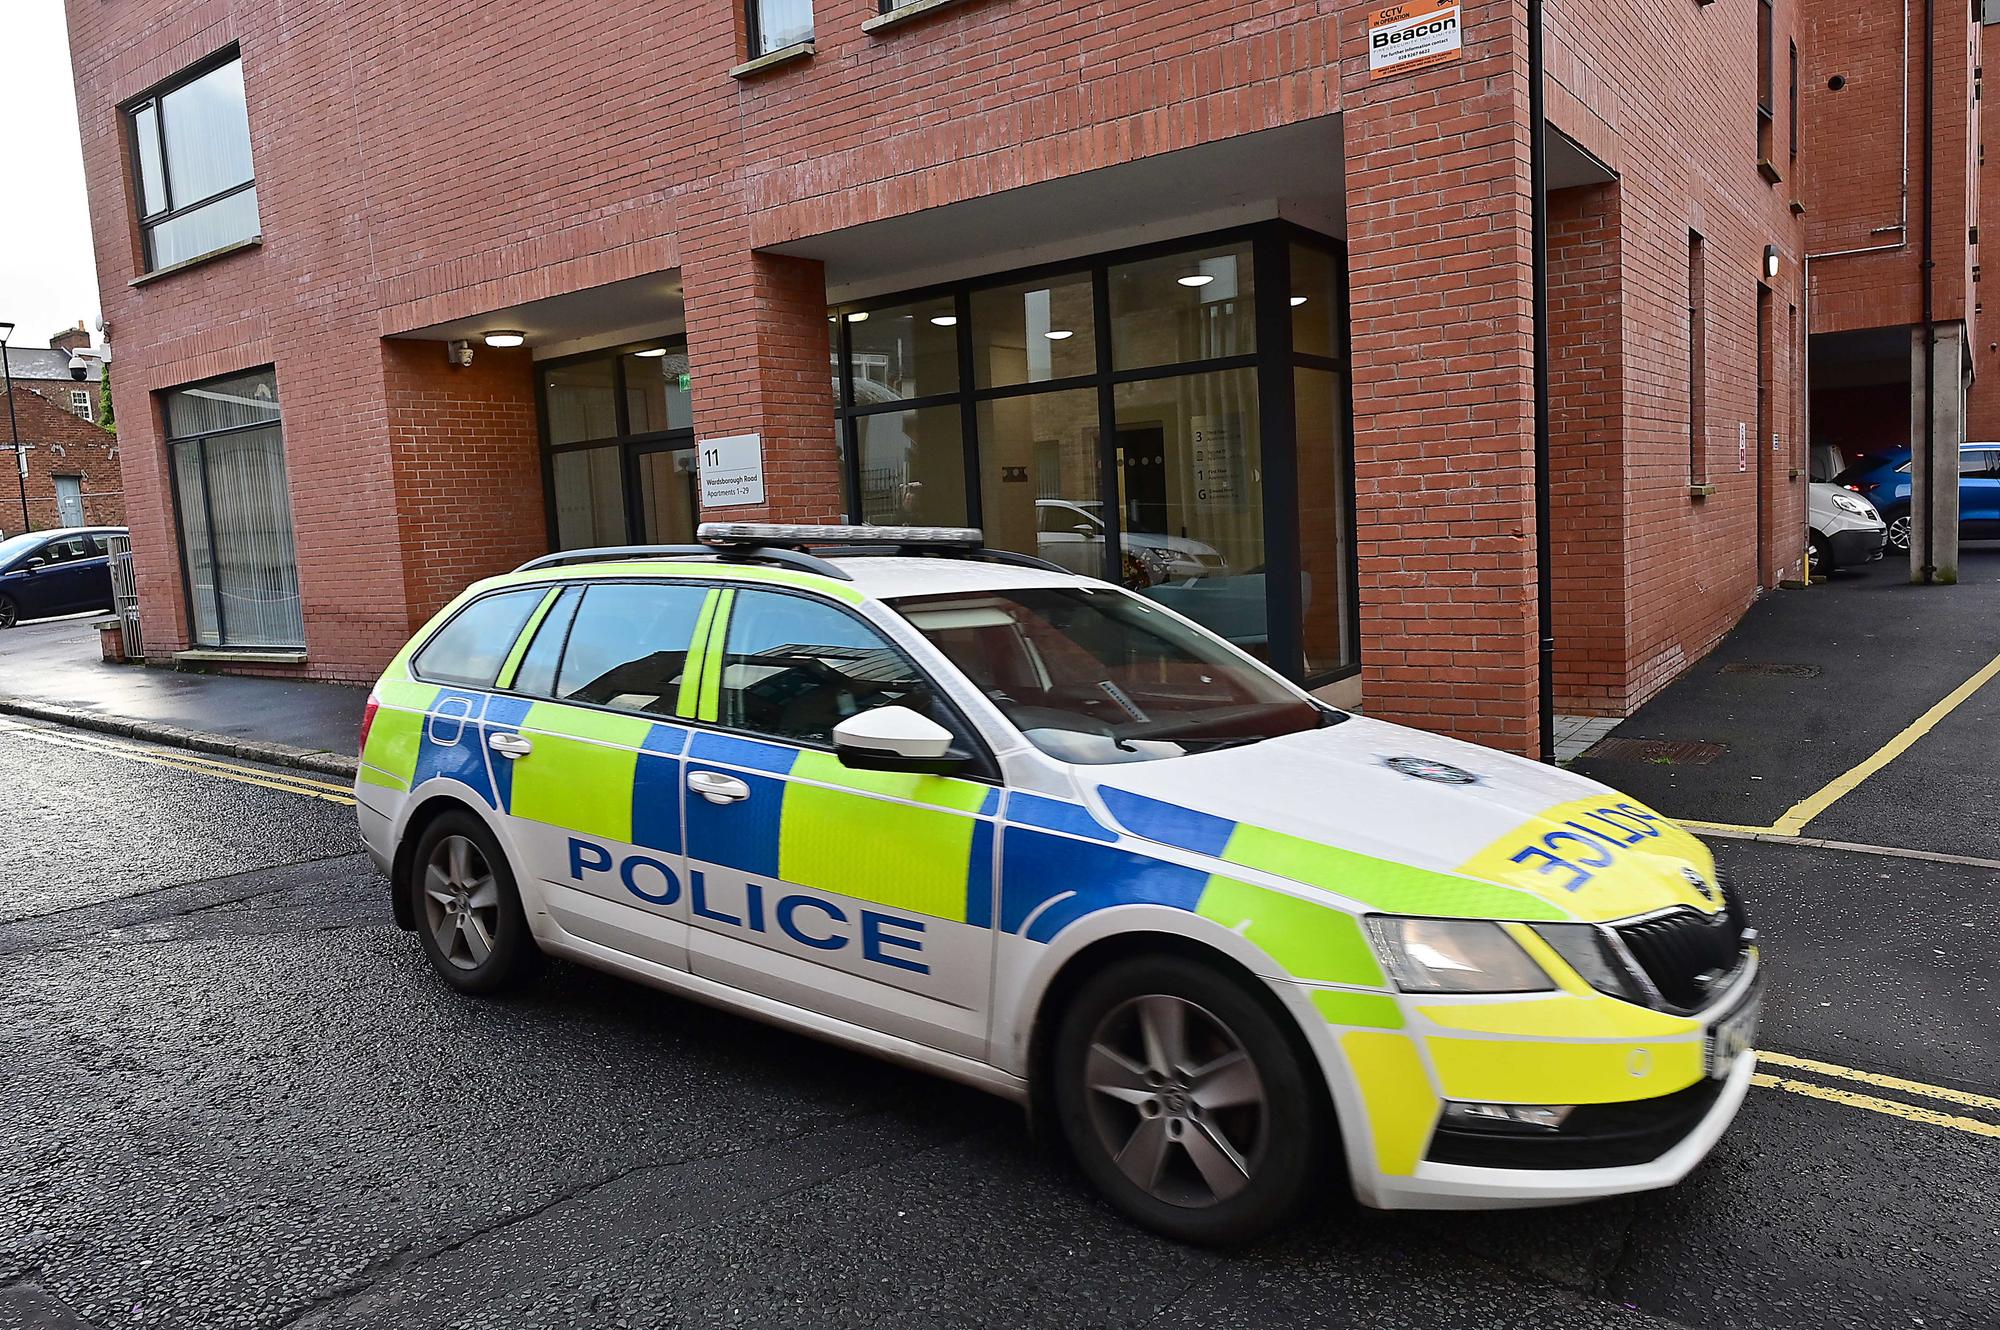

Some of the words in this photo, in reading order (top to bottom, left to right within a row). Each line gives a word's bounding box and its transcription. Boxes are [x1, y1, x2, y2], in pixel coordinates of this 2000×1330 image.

[1380, 6, 1403, 19] CCTV
[1380, 12, 1410, 24] OPERATION
[1373, 18, 1456, 49] Beacon
[1405, 43, 1430, 52] information
[1432, 38, 1448, 46] contact
[1196, 432, 1202, 442] 3
[705, 449, 719, 467] 11
[706, 475, 743, 486] Wardsborough
[1198, 471, 1203, 480] 1
[707, 488, 736, 498] Apartments
[1198, 489, 1206, 500] G
[1508, 803, 1675, 892] POLICE
[567, 836, 931, 976] POLICE
